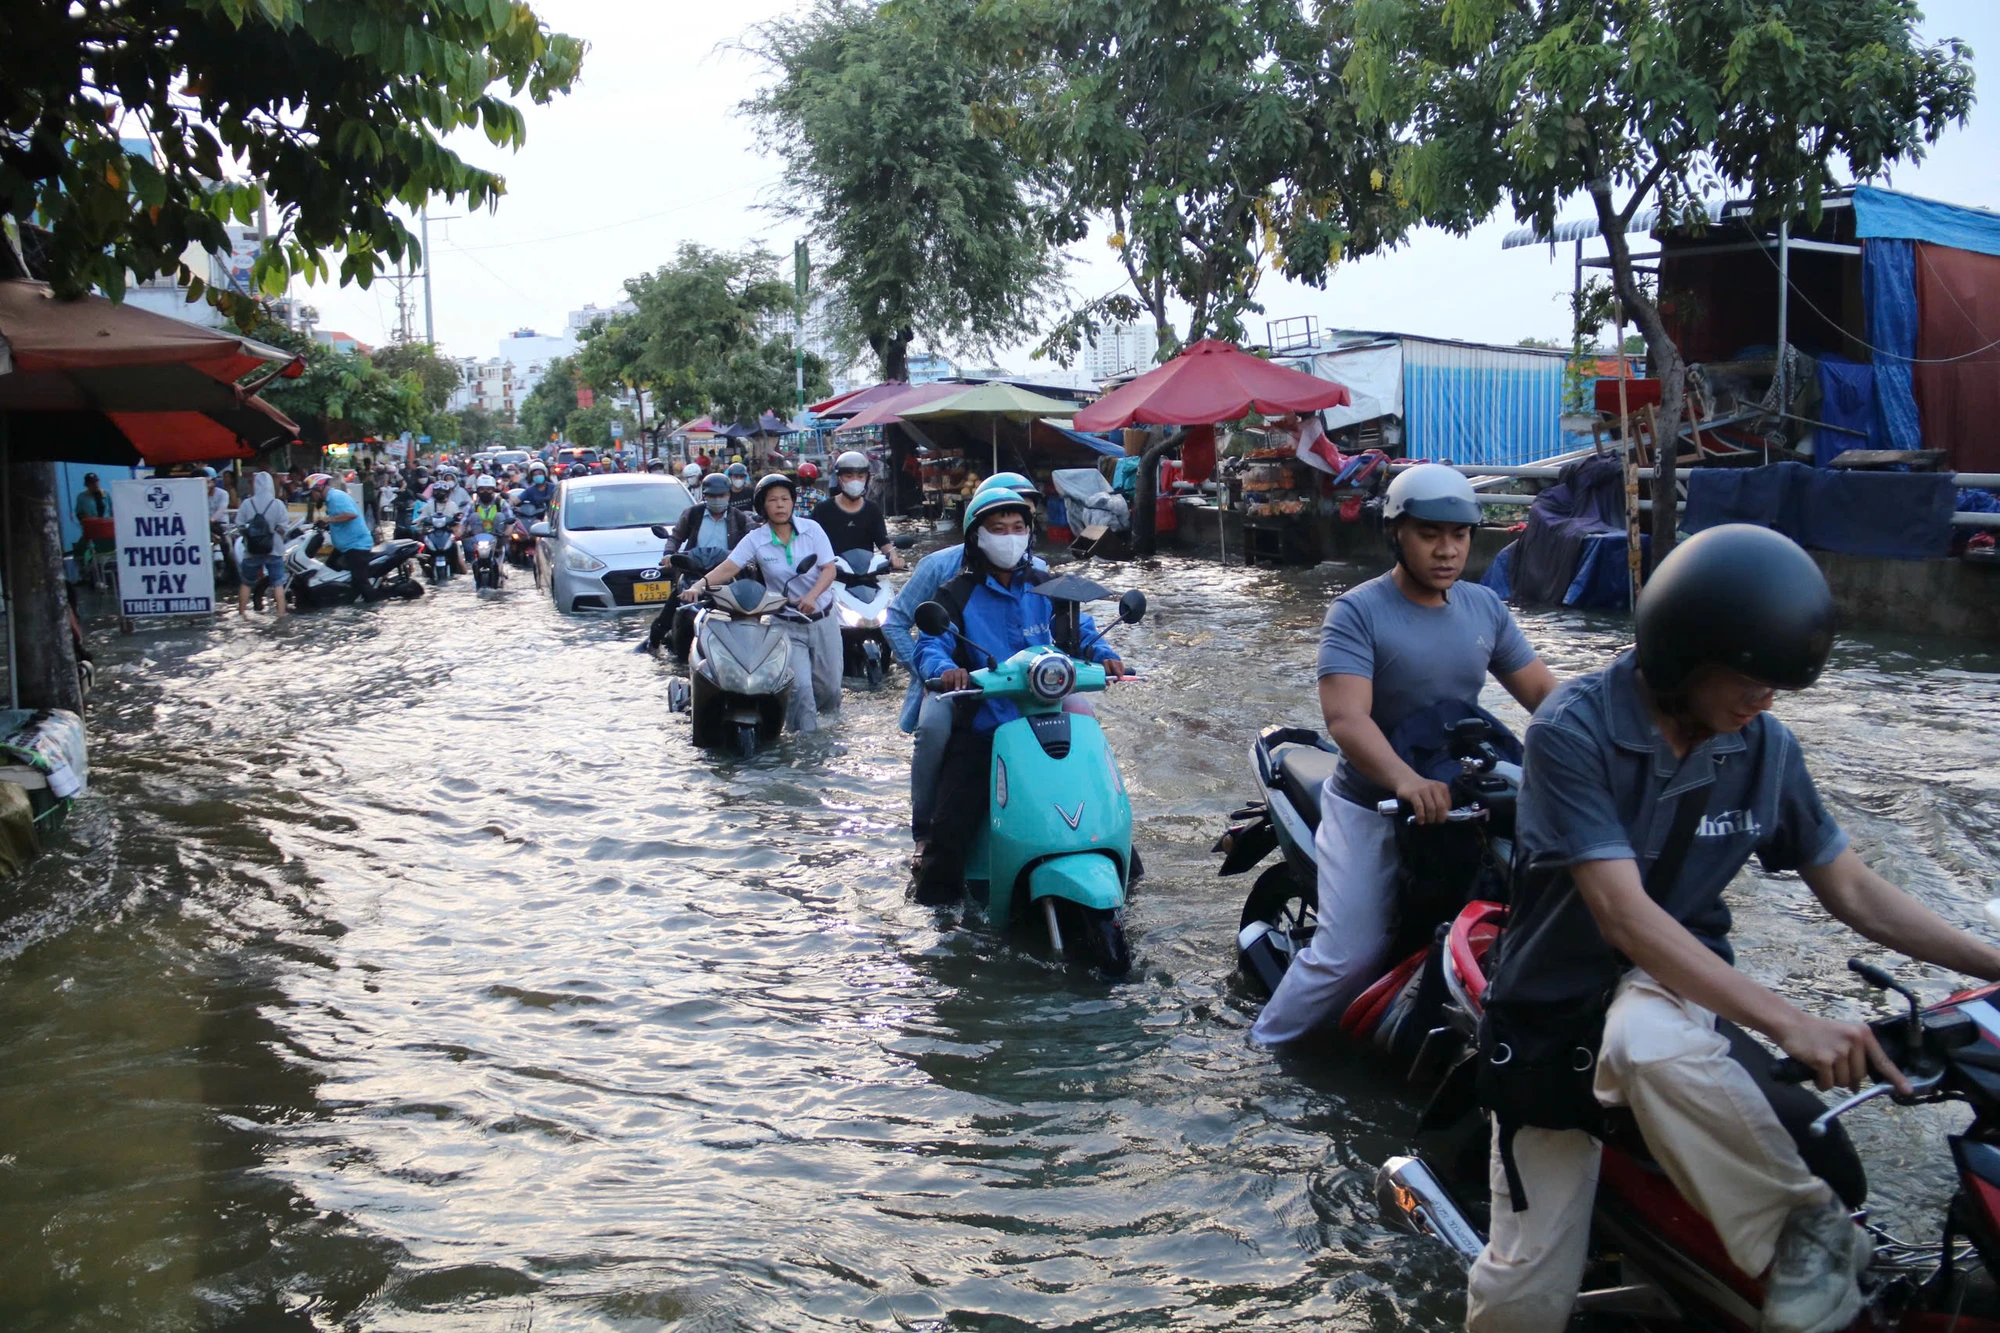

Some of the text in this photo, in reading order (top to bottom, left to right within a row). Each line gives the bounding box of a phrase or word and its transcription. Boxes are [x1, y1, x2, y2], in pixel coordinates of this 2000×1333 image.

[134, 512, 187, 537] NHÀ
[123, 538, 201, 567] THUỐC
[141, 570, 188, 595] TÂY
[644, 583, 660, 592] 76A
